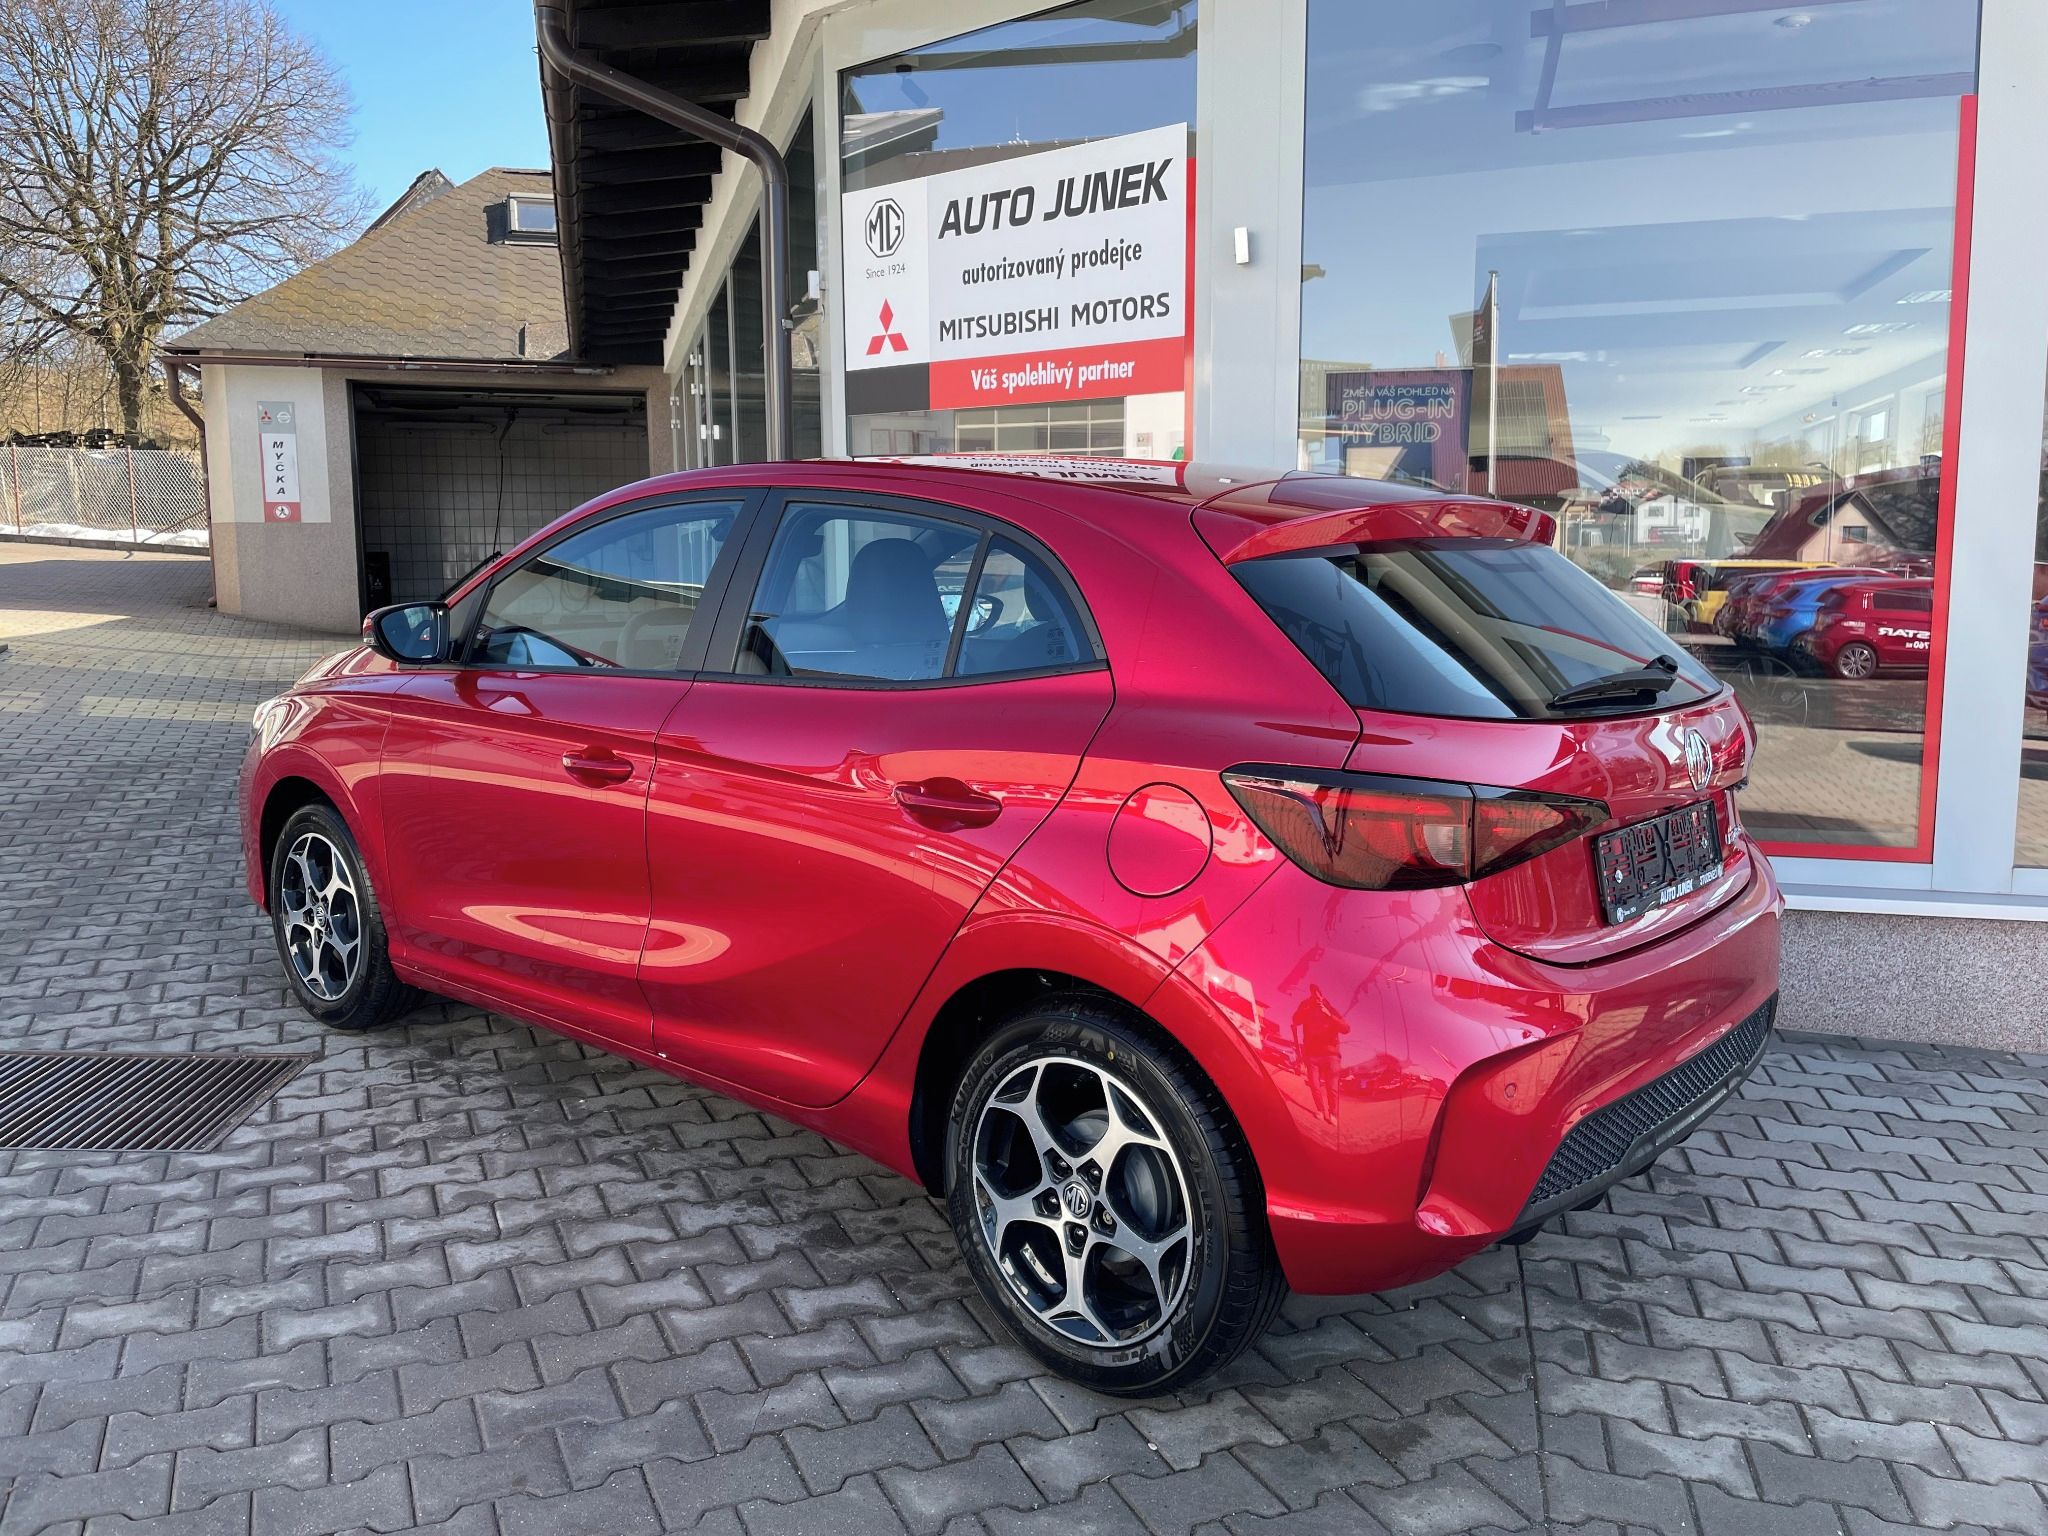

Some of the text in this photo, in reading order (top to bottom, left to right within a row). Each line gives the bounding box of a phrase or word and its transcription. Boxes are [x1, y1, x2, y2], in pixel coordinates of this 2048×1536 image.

[938, 157, 1174, 240] AUTO JUNEK
[867, 200, 903, 255] MG
[866, 263, 906, 280] Since 1924
[962, 238, 1142, 286] autorizovaný prodejce
[940, 292, 1170, 342] MITSUBISHI MOTORS
[971, 359, 1135, 394] Váš spolehlivý partner
[1376, 385, 1396, 397] VÁŠ
[1397, 386, 1438, 397] POHLED
[1440, 386, 1456, 396] NA
[1342, 398, 1454, 421] PLUG-IN
[1342, 422, 1441, 444] HYBRID
[272, 440, 286, 495] MYČKA
[1660, 886, 1676, 905] AUTO
[1065, 1185, 1090, 1216] MG
